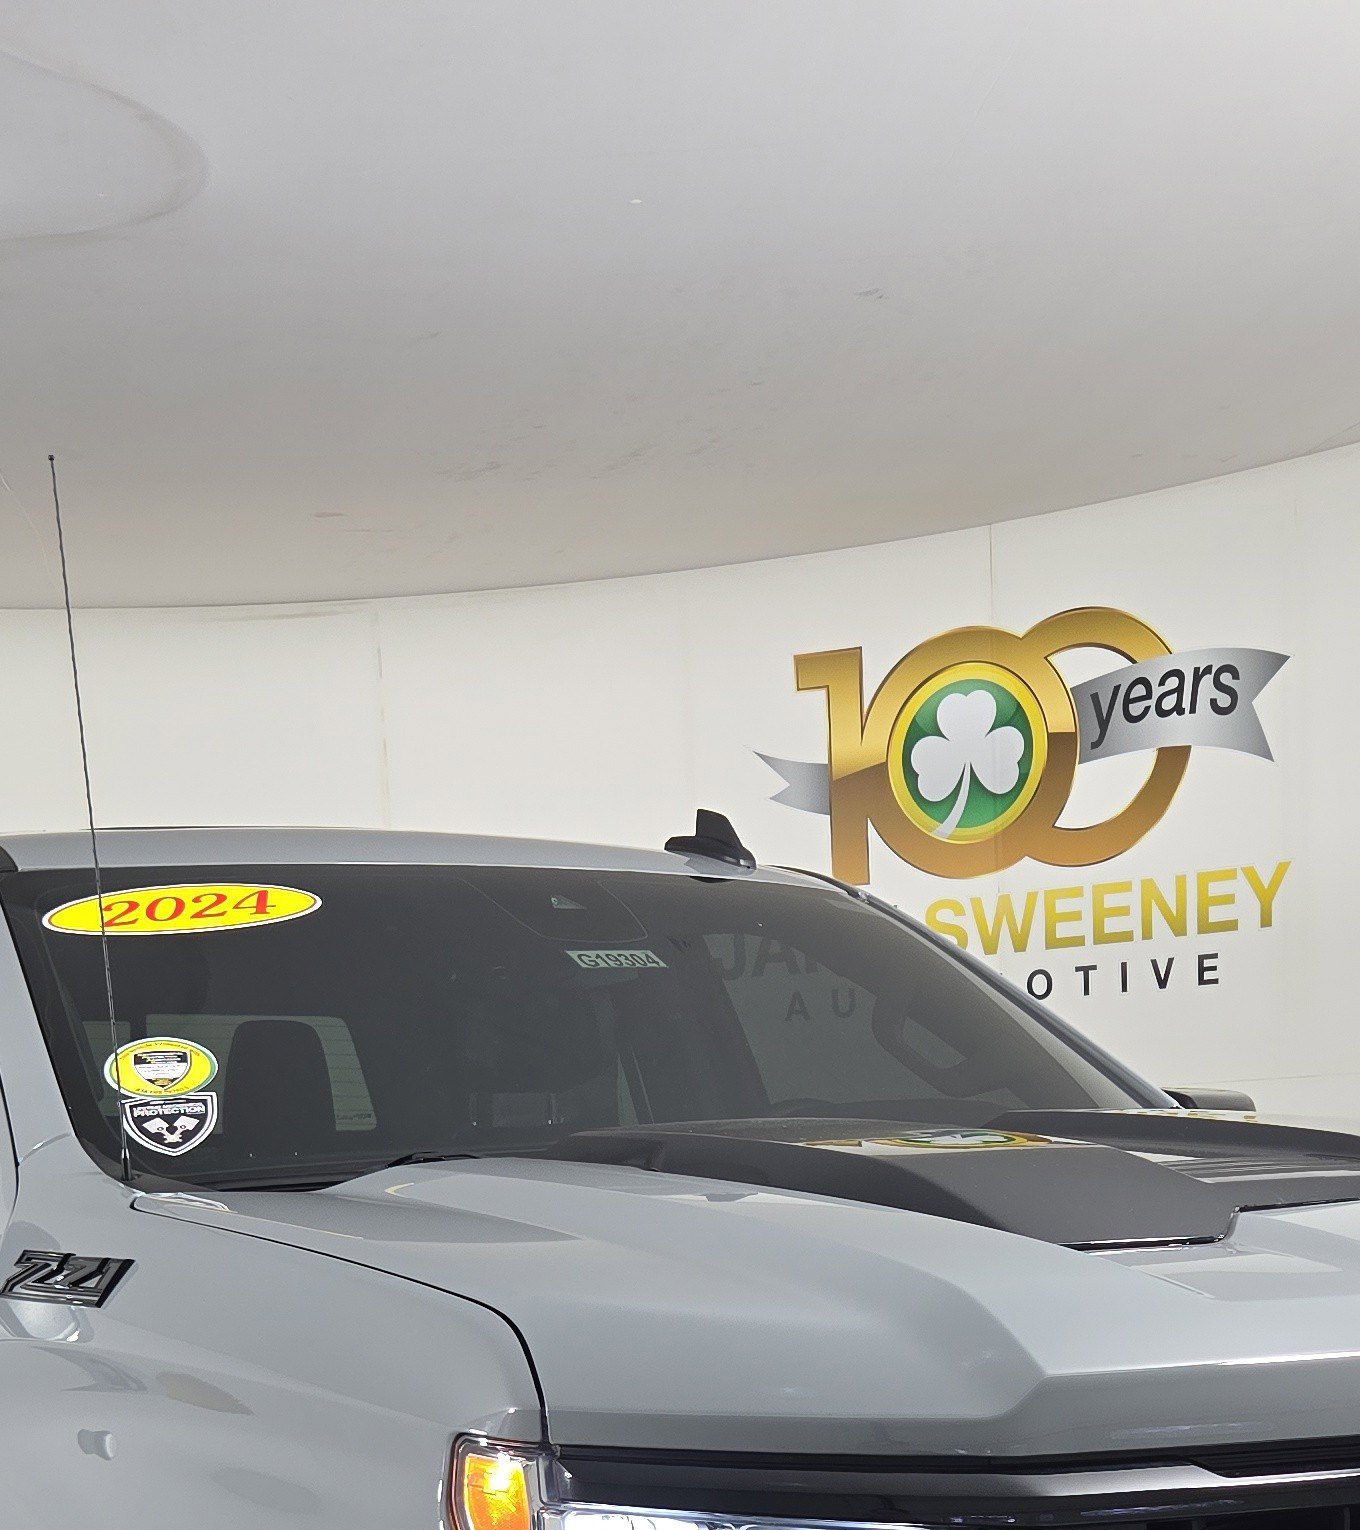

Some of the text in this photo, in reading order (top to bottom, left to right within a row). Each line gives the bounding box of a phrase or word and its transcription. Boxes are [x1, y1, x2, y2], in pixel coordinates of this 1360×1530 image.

[1089, 662, 1241, 750] years
[102, 888, 276, 928] 2024
[925, 861, 1291, 956] SWEENEY
[577, 953, 660, 968] G19304
[1026, 952, 1219, 1000] OTIVE
